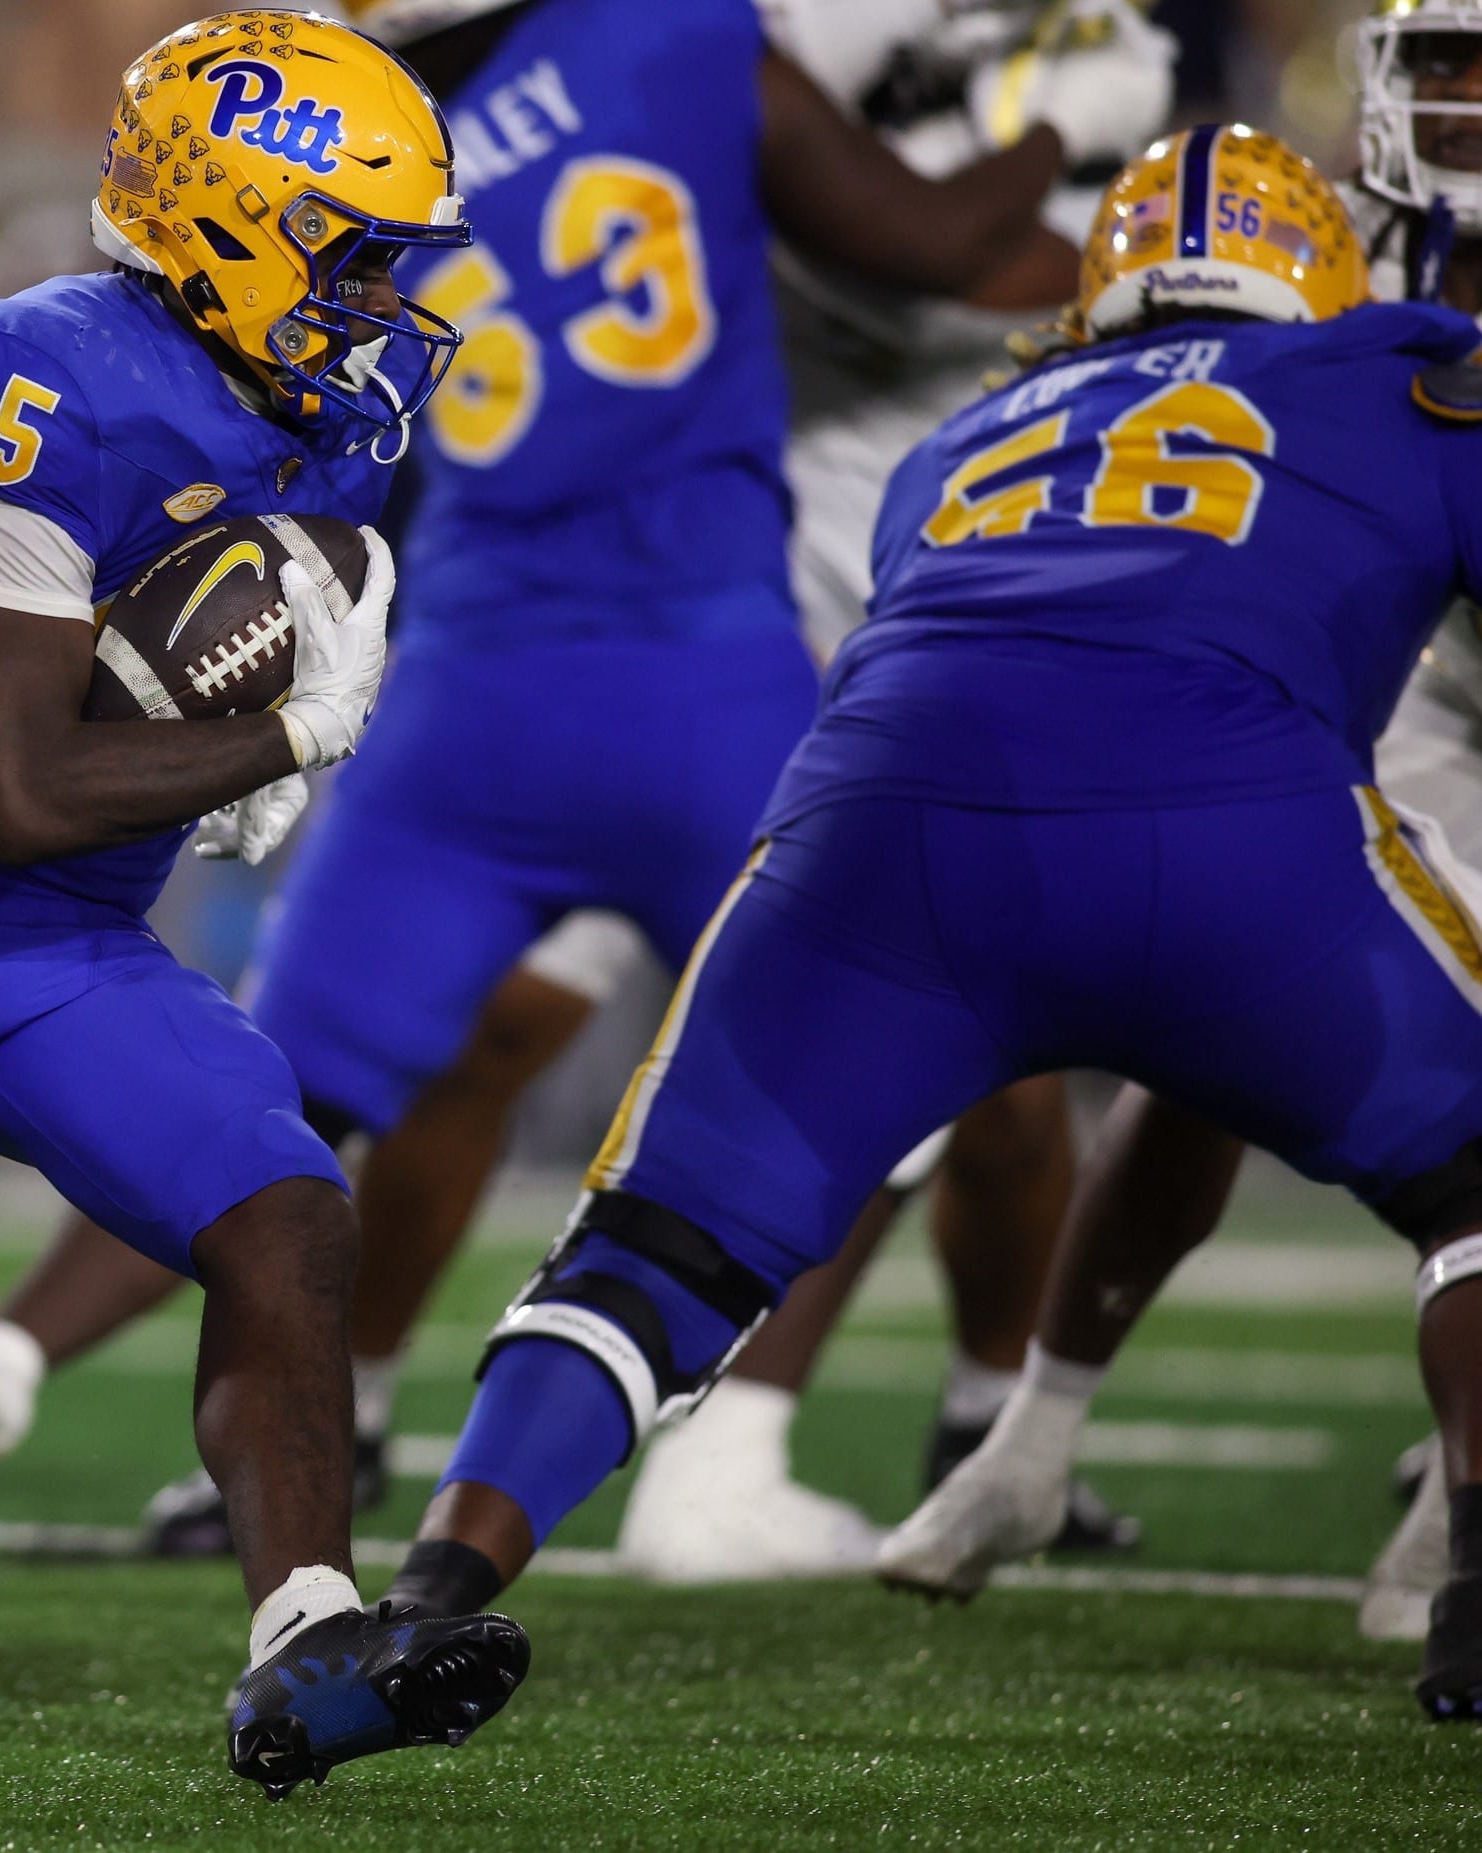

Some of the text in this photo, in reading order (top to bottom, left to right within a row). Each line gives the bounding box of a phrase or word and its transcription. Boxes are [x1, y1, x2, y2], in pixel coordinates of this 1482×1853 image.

[205, 58, 346, 177] Pitt
[1217, 191, 1261, 239] 56
[413, 153, 716, 466] 63
[1144, 270, 1238, 291] Panthers
[175, 493, 219, 510] ACC
[920, 379, 1274, 548] 56
